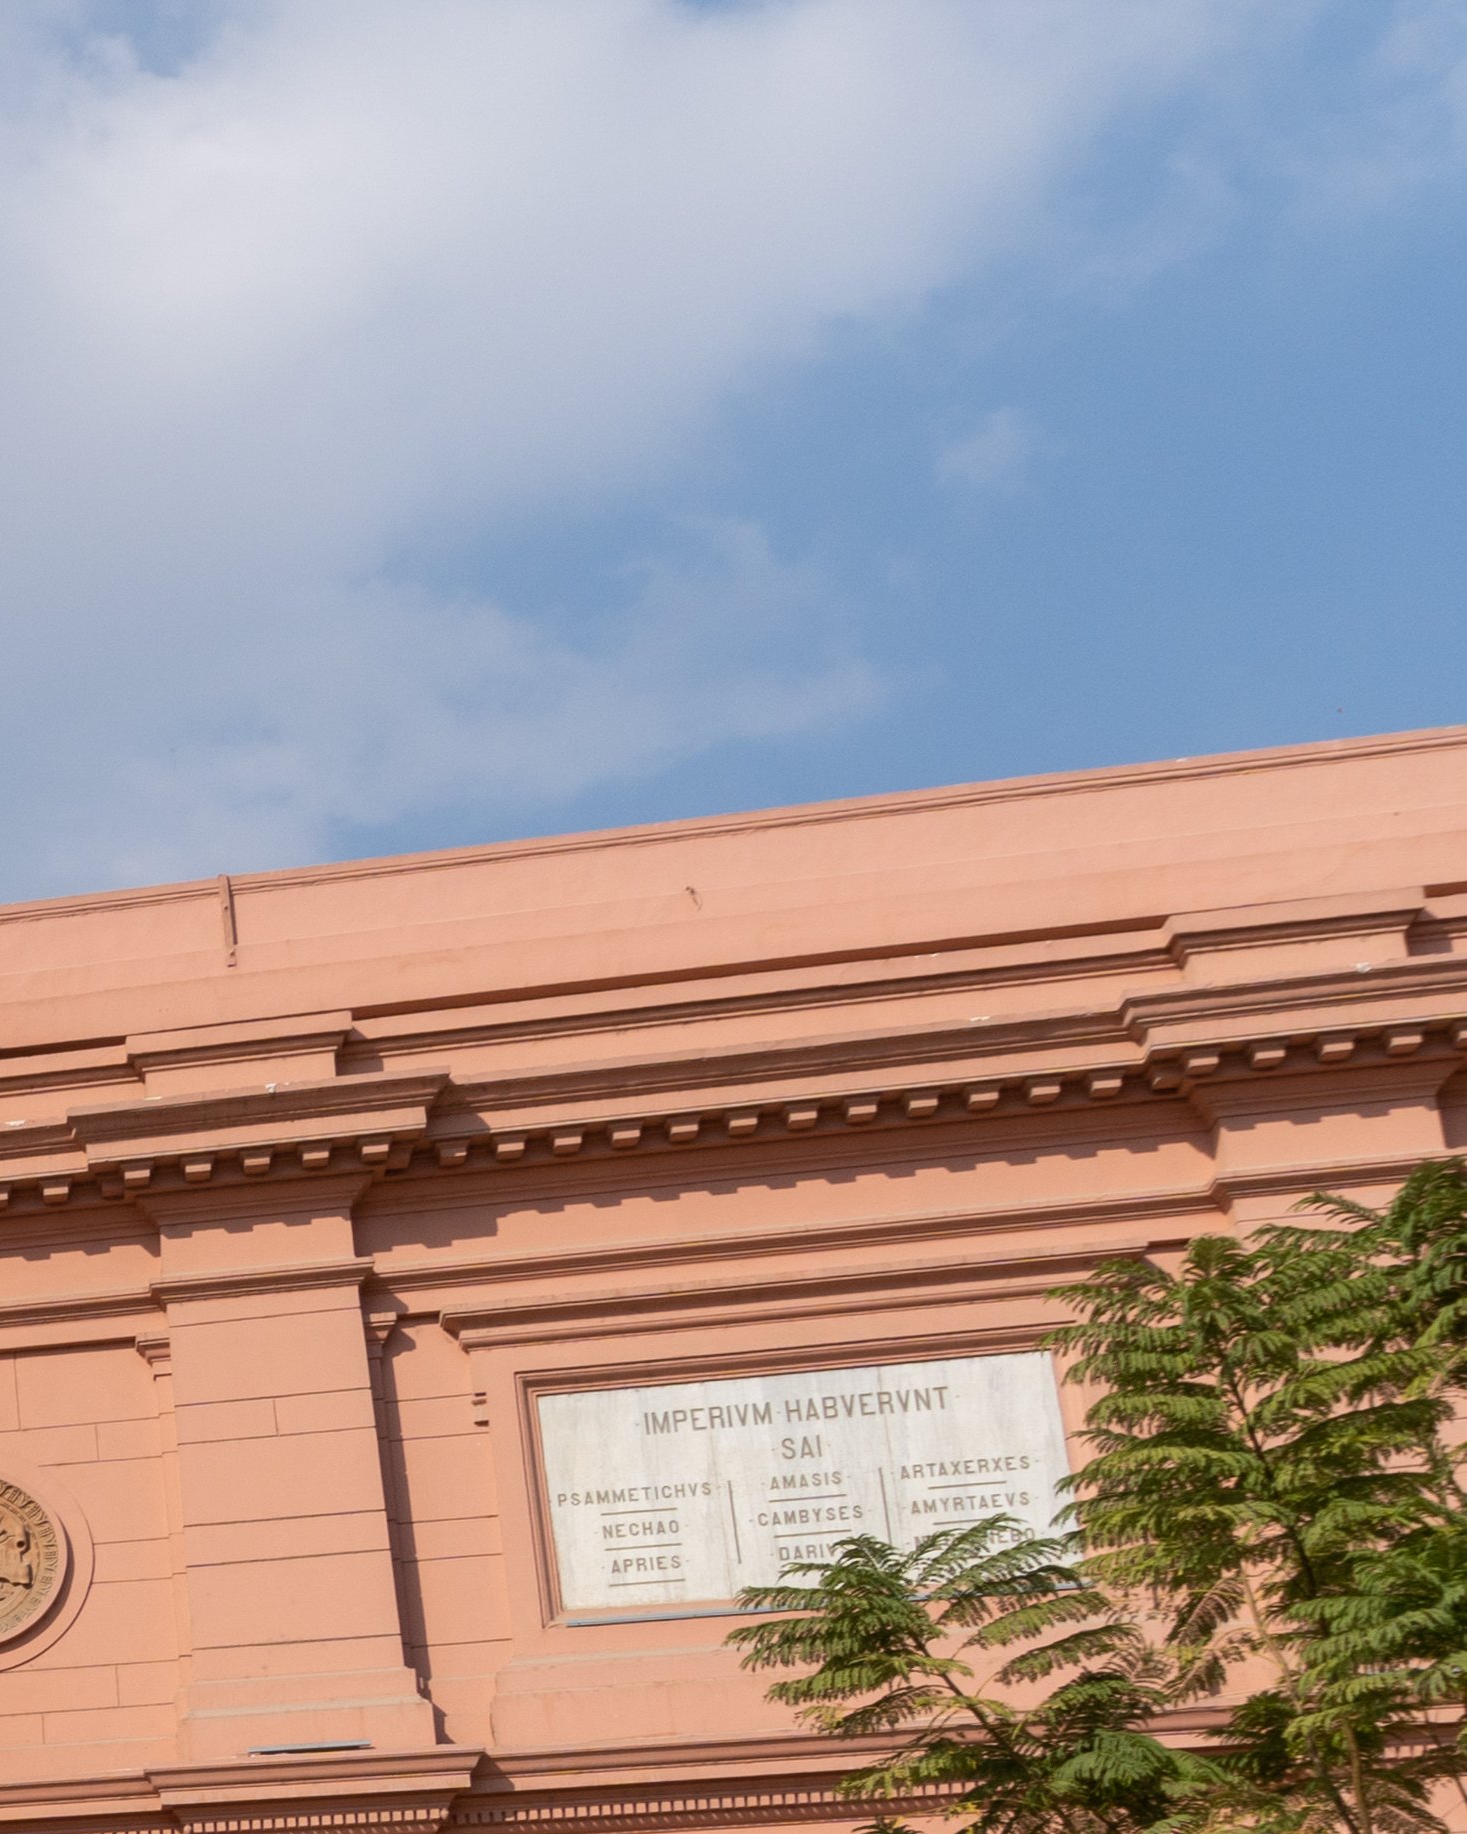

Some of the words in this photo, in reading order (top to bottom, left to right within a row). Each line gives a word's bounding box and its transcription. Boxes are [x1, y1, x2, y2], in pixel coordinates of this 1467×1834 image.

[643, 1400, 773, 1436] IMPERIVM
[785, 1386, 949, 1424] HABVERVNT
[781, 1435, 824, 1461] SAI
[900, 1456, 1031, 1481] ARTAXERXES
[769, 1471, 843, 1491] AMASIS
[557, 1481, 713, 1508] PSAMMETICHVS
[910, 1492, 1031, 1516] AMYRTAEVS
[757, 1505, 864, 1528] CAMBYSES
[602, 1520, 681, 1540] NECHAO
[611, 1554, 682, 1575] APRIES
